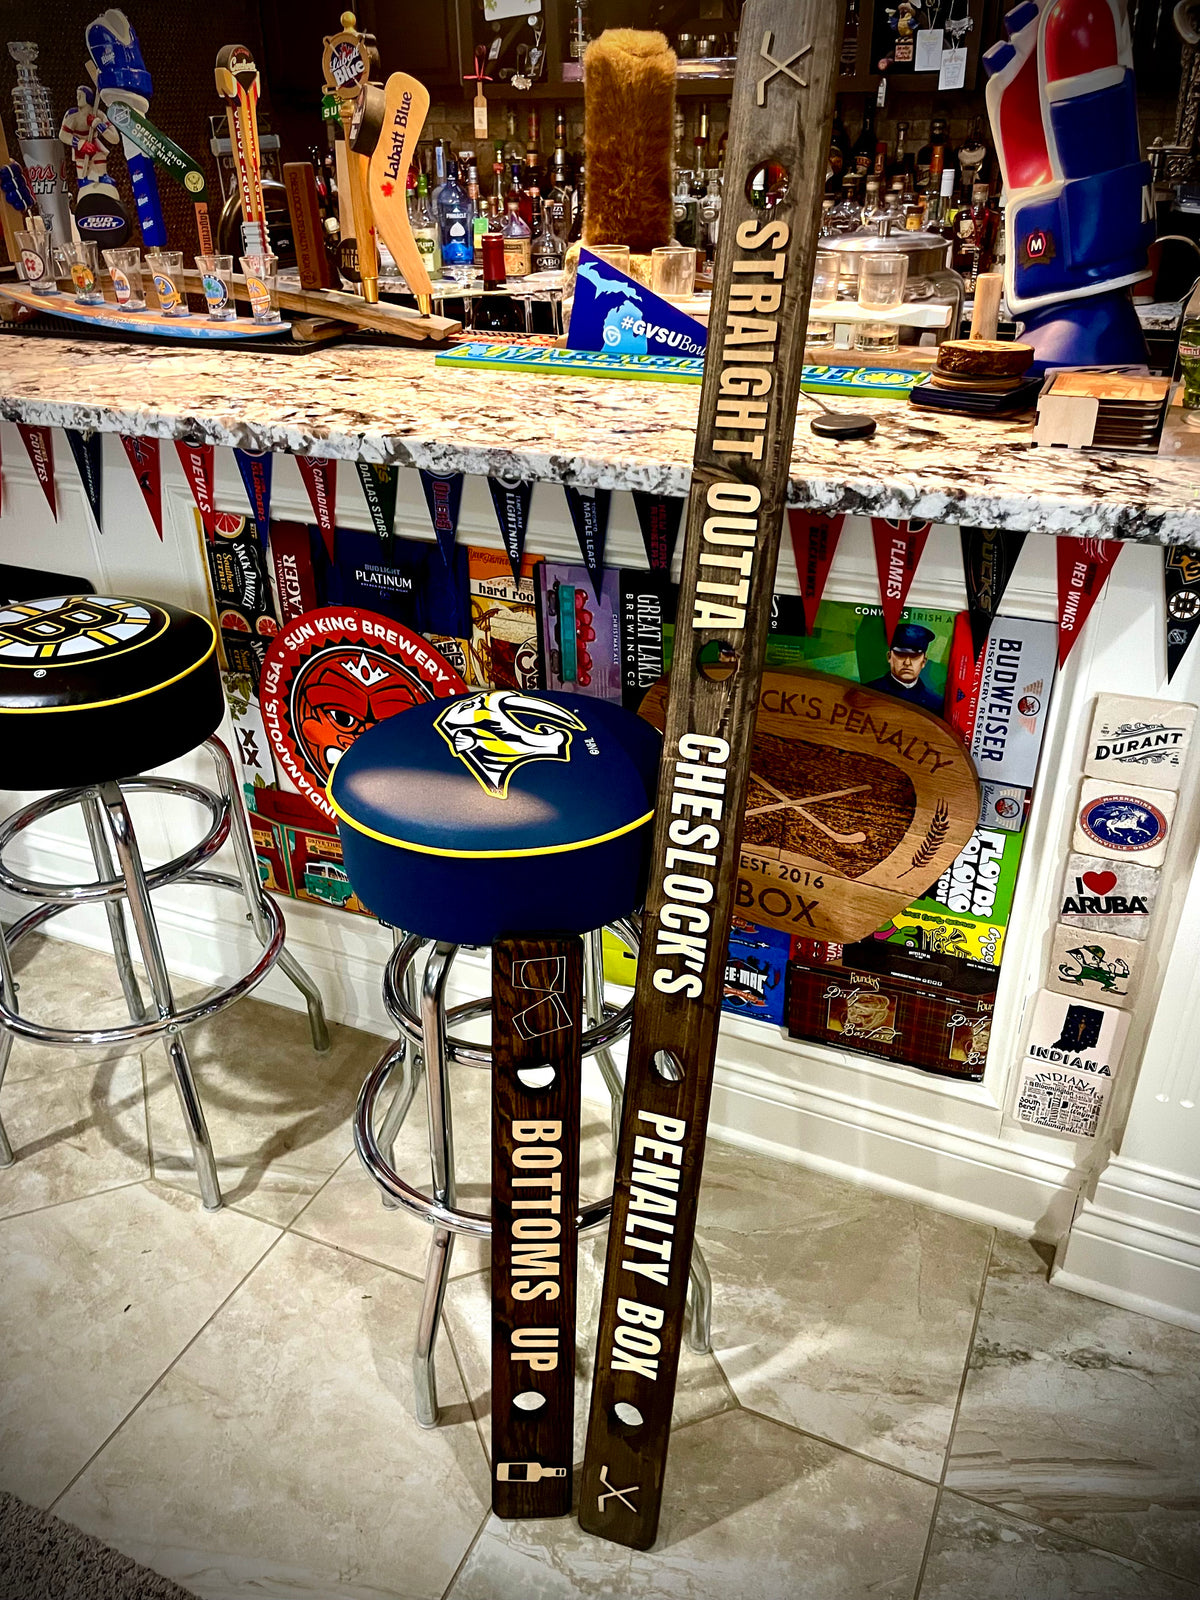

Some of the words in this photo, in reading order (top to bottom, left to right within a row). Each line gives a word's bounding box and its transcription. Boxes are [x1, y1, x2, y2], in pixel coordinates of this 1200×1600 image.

[330, 46, 360, 71] Labatt
[333, 60, 365, 86] Blue
[394, 90, 414, 128] Blue
[131, 129, 142, 139] OF
[141, 136, 156, 152] THE
[155, 149, 172, 166] NHL
[135, 123, 166, 152] OFFICIAL
[166, 150, 188, 169] SHOT
[234, 110, 245, 159] CZECH
[241, 165, 252, 213] LAGER
[384, 131, 405, 181] Labatt
[536, 257, 561, 267] CABO
[1031, 238, 1043, 253] M
[714, 220, 789, 462] STRAIGHT
[29, 433, 48, 482] COYOTES
[190, 453, 211, 514] DEVILS
[250, 462, 266, 521] ISLANDERS
[312, 468, 331, 530] CANADIENS
[359, 463, 379, 503] DALLAS
[371, 505, 389, 539] STARS
[506, 492, 519, 559] LIGHTNING
[583, 501, 593, 537] MAPLE
[658, 504, 667, 531] NEW
[232, 543, 252, 570] JACK
[586, 539, 597, 569] LEAFS
[650, 506, 660, 570] RANGERS
[660, 534, 668, 570] YORK
[692, 481, 763, 632] OUTTA
[216, 553, 227, 591] CITRUS
[222, 552, 235, 594] Southern
[355, 570, 412, 589] PLATINUM
[364, 563, 380, 573] BUD
[380, 565, 401, 575] LIGHT
[805, 526, 820, 599] BLACKHAWKS
[886, 538, 907, 600] FLAMES
[1071, 561, 1088, 588] RED
[241, 570, 257, 611] DANIEL'S
[277, 558, 289, 612] TRADITIONAL
[283, 554, 304, 619] LAGER
[478, 582, 507, 598] hard
[625, 593, 635, 663] BREWING
[636, 594, 662, 642] GREAT
[912, 612, 943, 623] IRISH
[1060, 591, 1081, 631] WINGS
[284, 622, 316, 651] SUN
[314, 616, 358, 634] KING
[361, 619, 450, 683] BREWERY
[637, 644, 662, 688] LAKES
[264, 661, 284, 695] USA
[980, 638, 997, 703] DISCOVERY
[980, 638, 1023, 762] BUDWEISER
[829, 702, 954, 775] PENALTY
[972, 707, 986, 758] RESERVE
[1094, 732, 1183, 761] DURANT
[979, 785, 995, 823] Budweiser
[1081, 822, 1128, 851] WILSONVILLE
[1132, 836, 1162, 851] OREGON
[652, 732, 730, 1000] CHESLOCK'S
[739, 854, 772, 876] EST.
[778, 865, 825, 890] 2016
[935, 867, 951, 905] TOUT
[947, 830, 983, 914] OLOKO
[971, 829, 1007, 918] FLOYDS
[1075, 876, 1084, 895] I
[735, 877, 820, 928] BOX
[822, 985, 861, 1006] Dirty
[850, 972, 881, 990] Founders
[839, 1023, 903, 1044] Bastard
[947, 1013, 988, 1035] Dirty
[1029, 1044, 1112, 1077] INDIANA
[1034, 1081, 1074, 1097] Bloomington
[1035, 1072, 1096, 1095] INDIANA
[1034, 1117, 1078, 1133] Indianapolis
[1070, 1109, 1095, 1119] Wayne
[1071, 1102, 1086, 1111] Fort
[511, 1119, 563, 1302] BOTTOMS
[622, 1109, 687, 1287] PENALTY
[511, 1326, 559, 1374] UP
[611, 1296, 664, 1382] BOX
